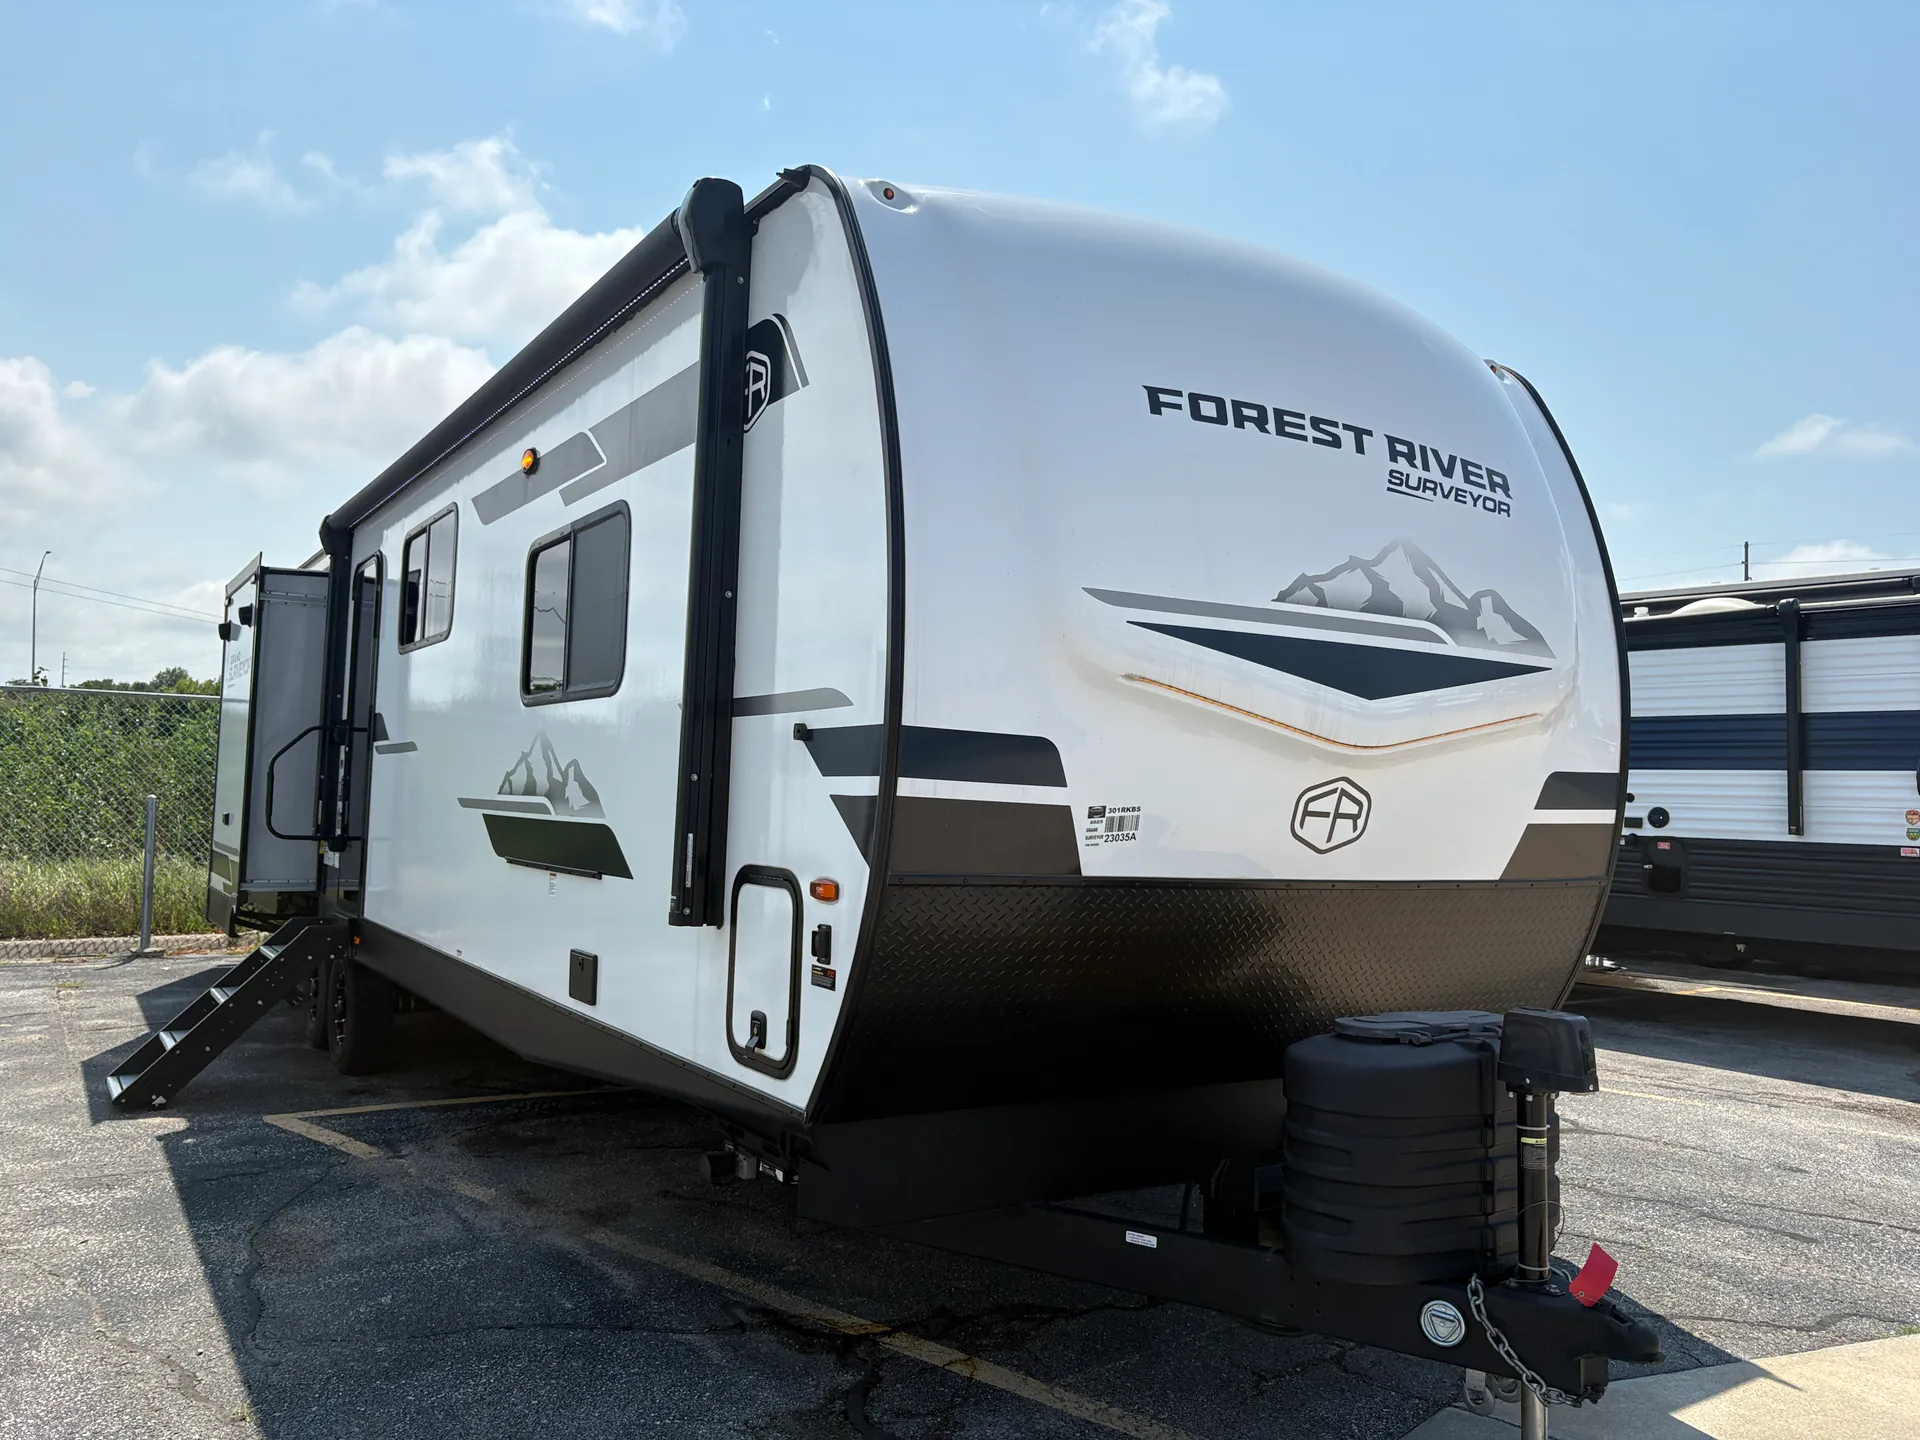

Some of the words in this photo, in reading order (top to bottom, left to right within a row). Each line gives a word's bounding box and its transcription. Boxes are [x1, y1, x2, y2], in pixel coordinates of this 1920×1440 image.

[1142, 385, 1373, 456] FOREST
[1384, 433, 1513, 500] RIVER
[1387, 469, 1511, 518] SURVEYOR
[1107, 805, 1141, 814] 301RKBS
[1104, 832, 1137, 843] 23035A
